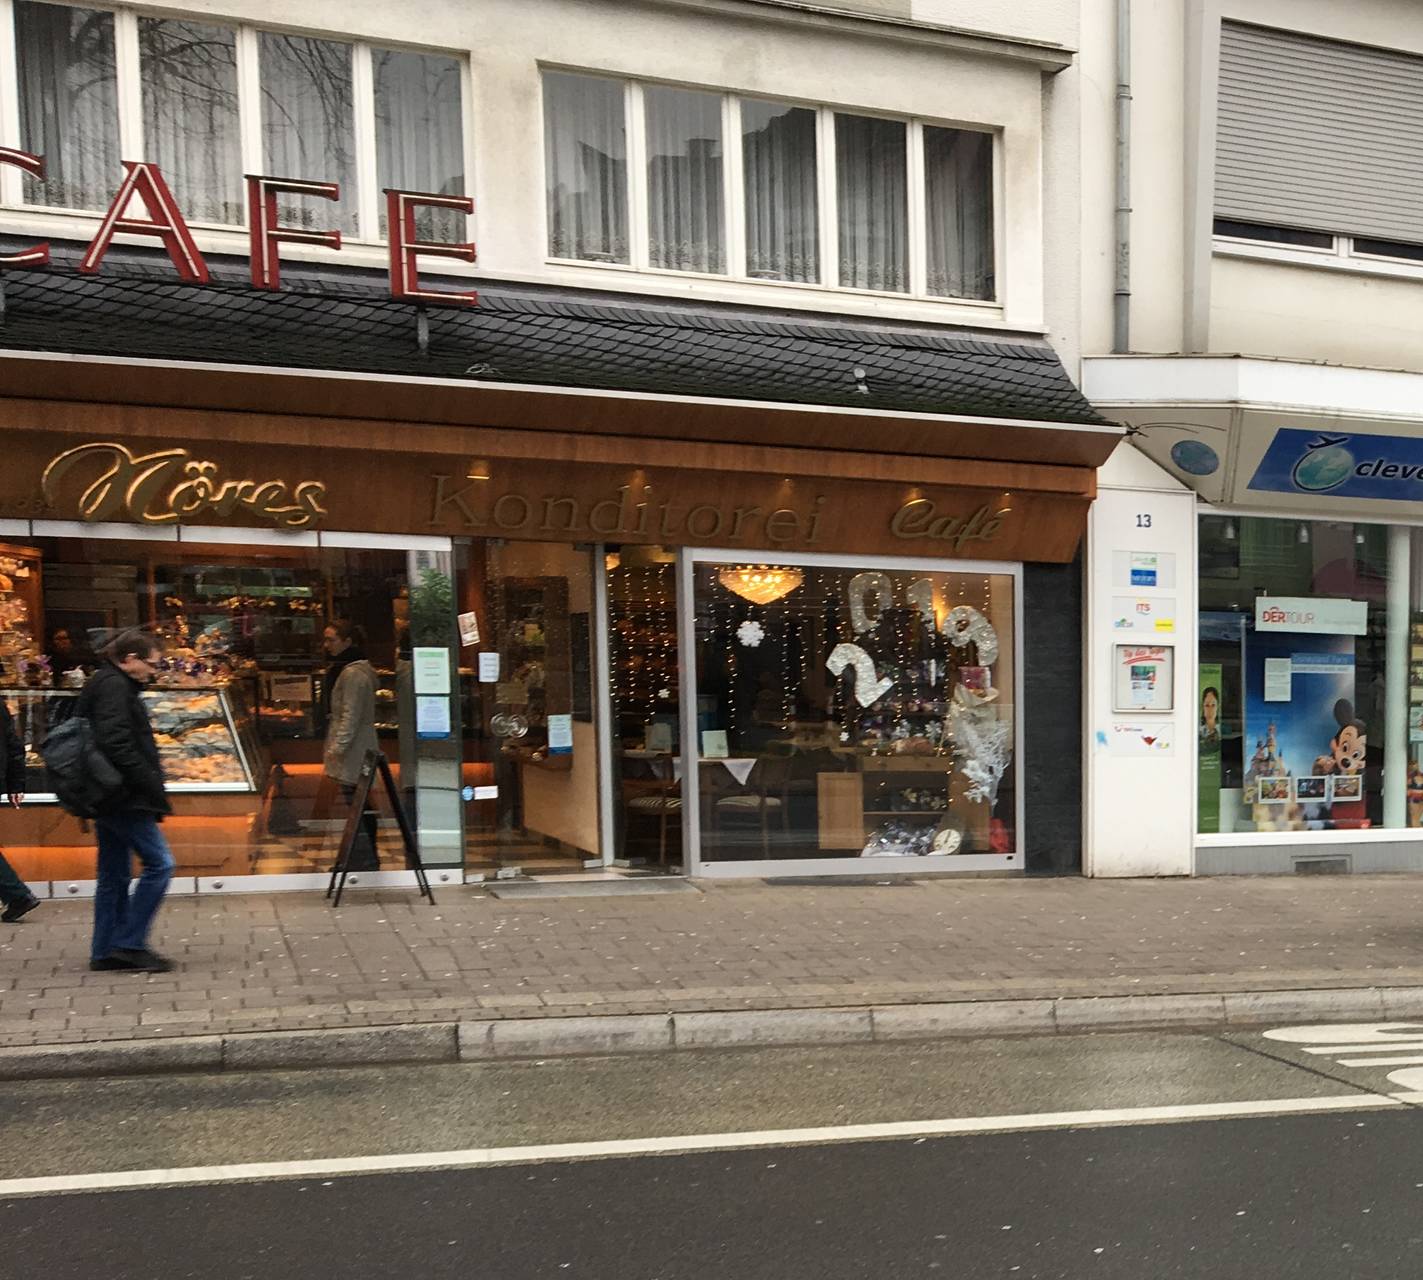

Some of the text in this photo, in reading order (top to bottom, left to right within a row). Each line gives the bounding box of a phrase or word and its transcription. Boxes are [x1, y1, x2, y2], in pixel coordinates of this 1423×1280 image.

[427, 473, 828, 545] Konditorei
[890, 497, 1013, 549] Café
[1136, 513, 1152, 528] 13
